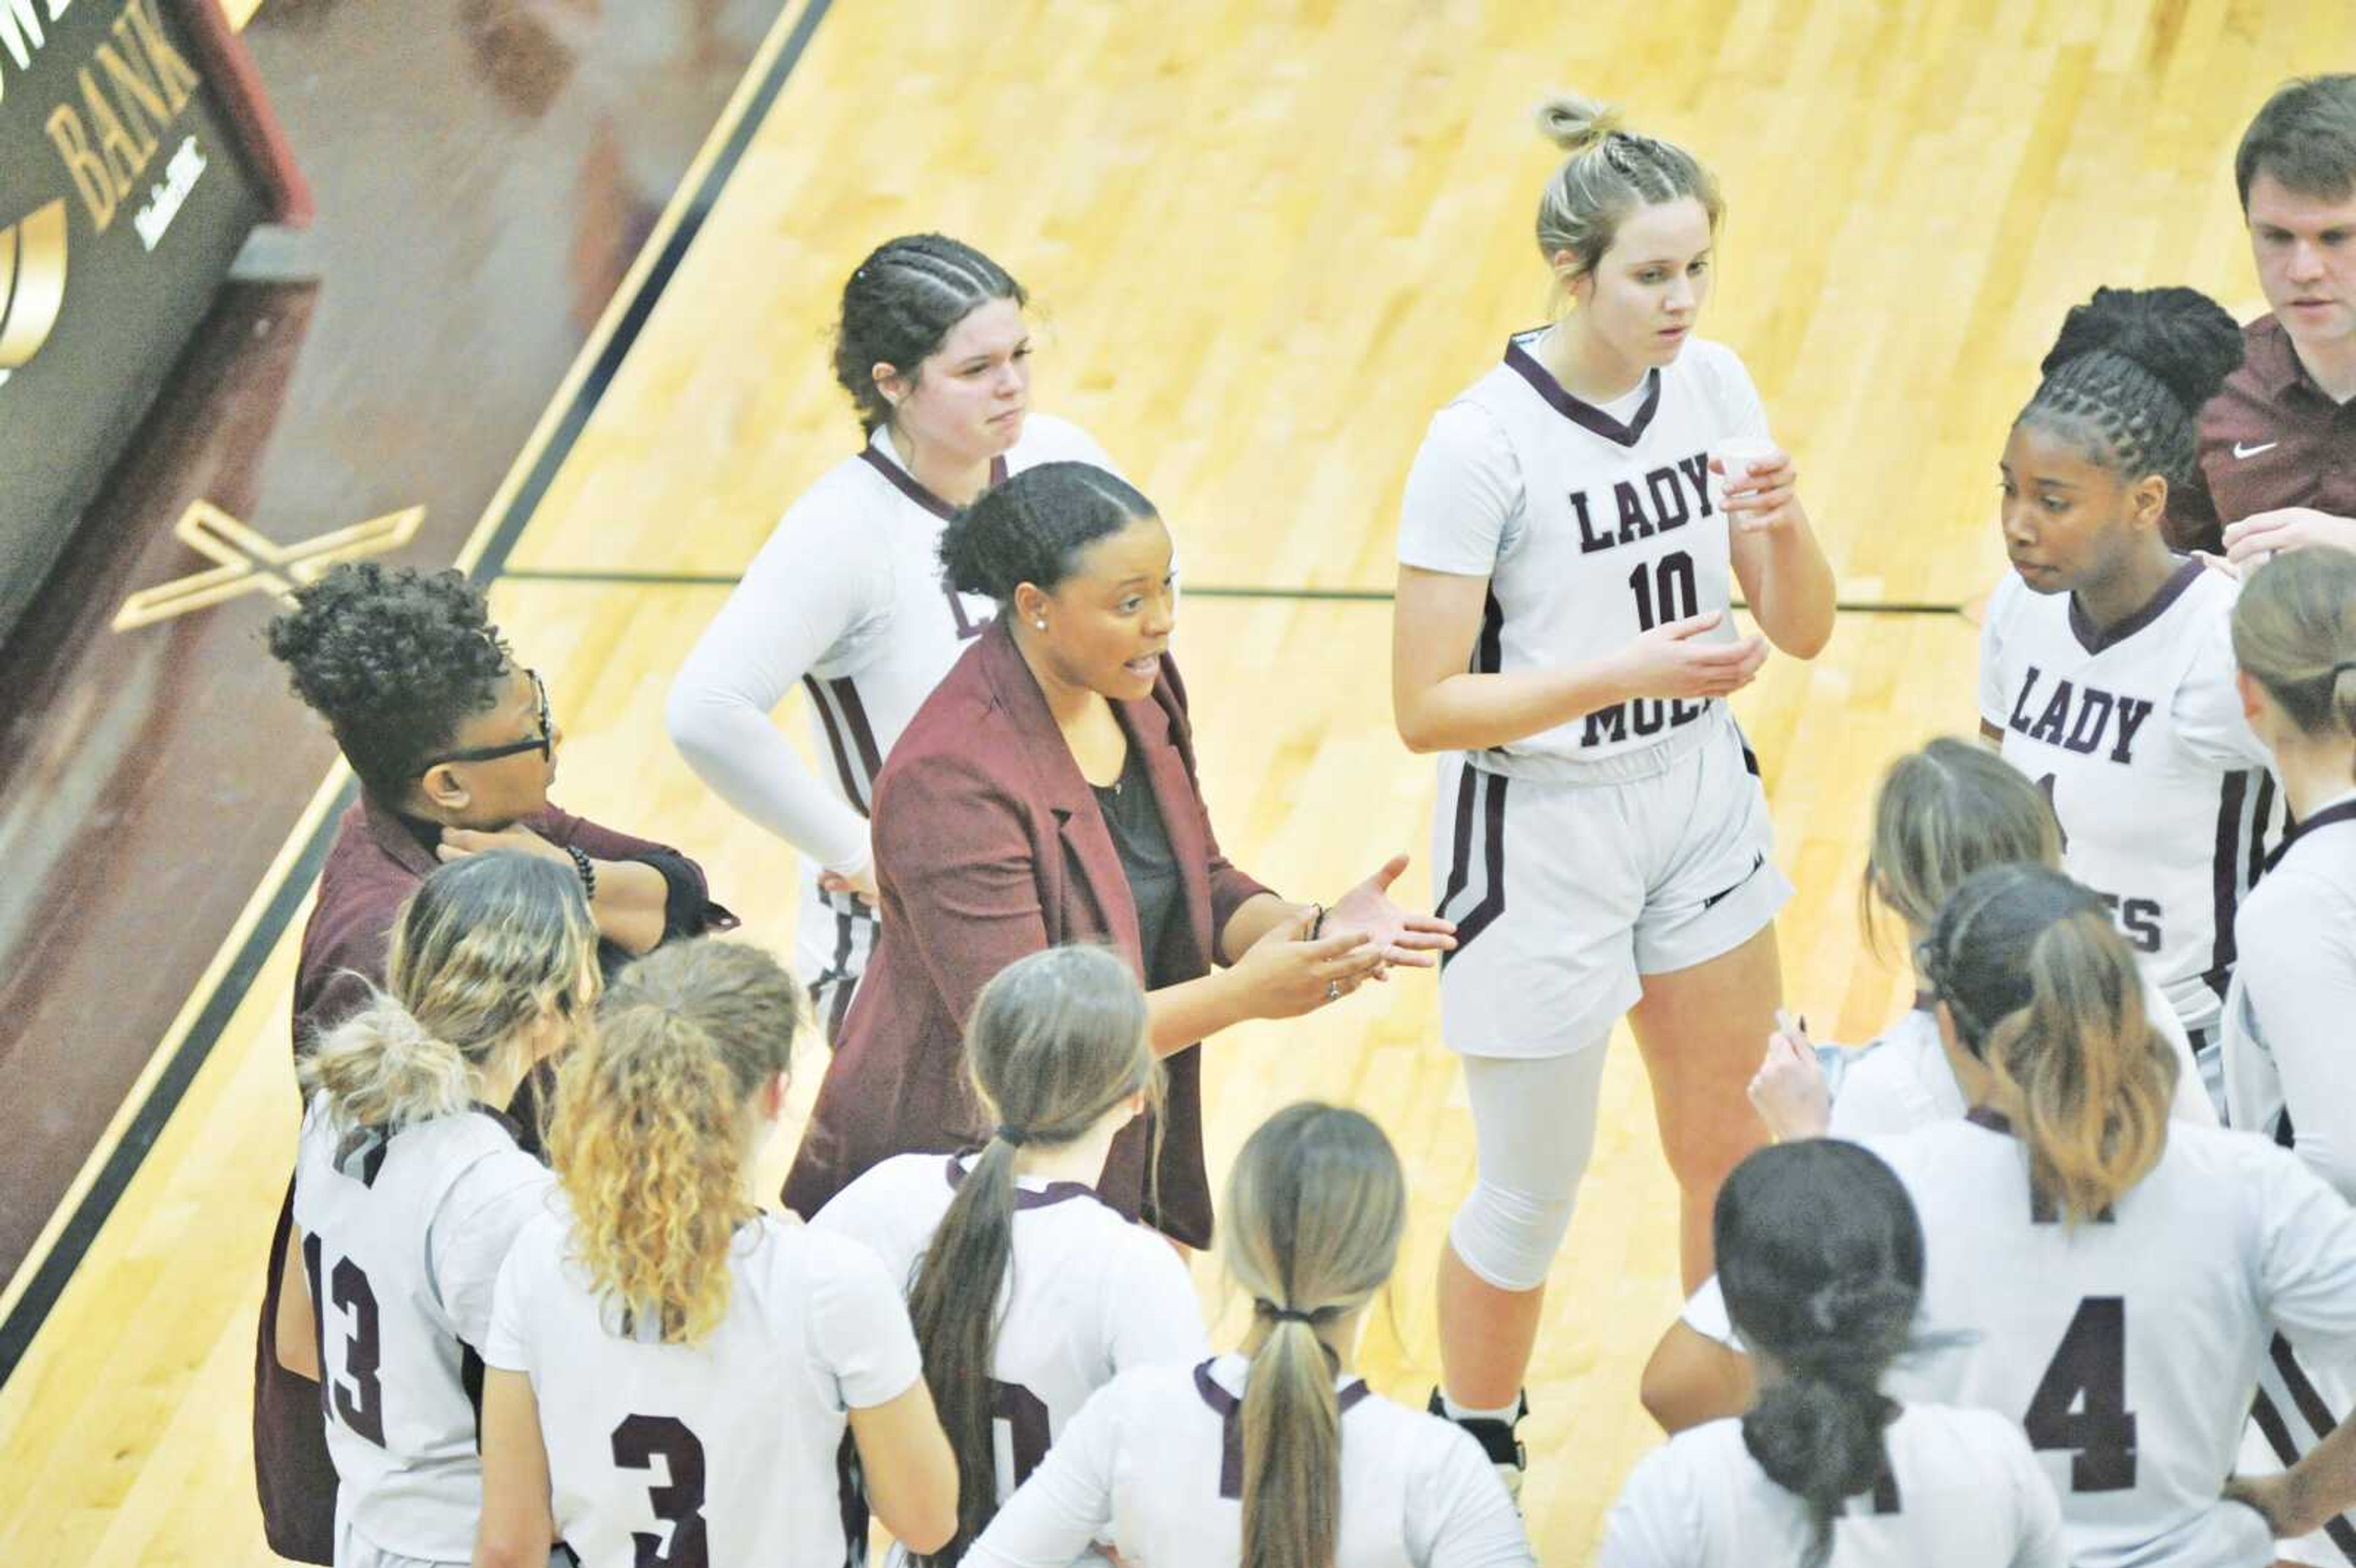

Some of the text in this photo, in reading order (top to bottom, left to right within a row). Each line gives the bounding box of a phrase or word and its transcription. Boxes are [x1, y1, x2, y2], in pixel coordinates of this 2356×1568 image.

[45, 0, 200, 237] BANK
[1569, 453, 1713, 553] LADY
[1629, 550, 1698, 632] 10
[1581, 697, 1714, 747] MUL
[2009, 666, 2154, 764] LADY
[2024, 1296, 2137, 1493] 4
[610, 1413, 709, 1568] 3
